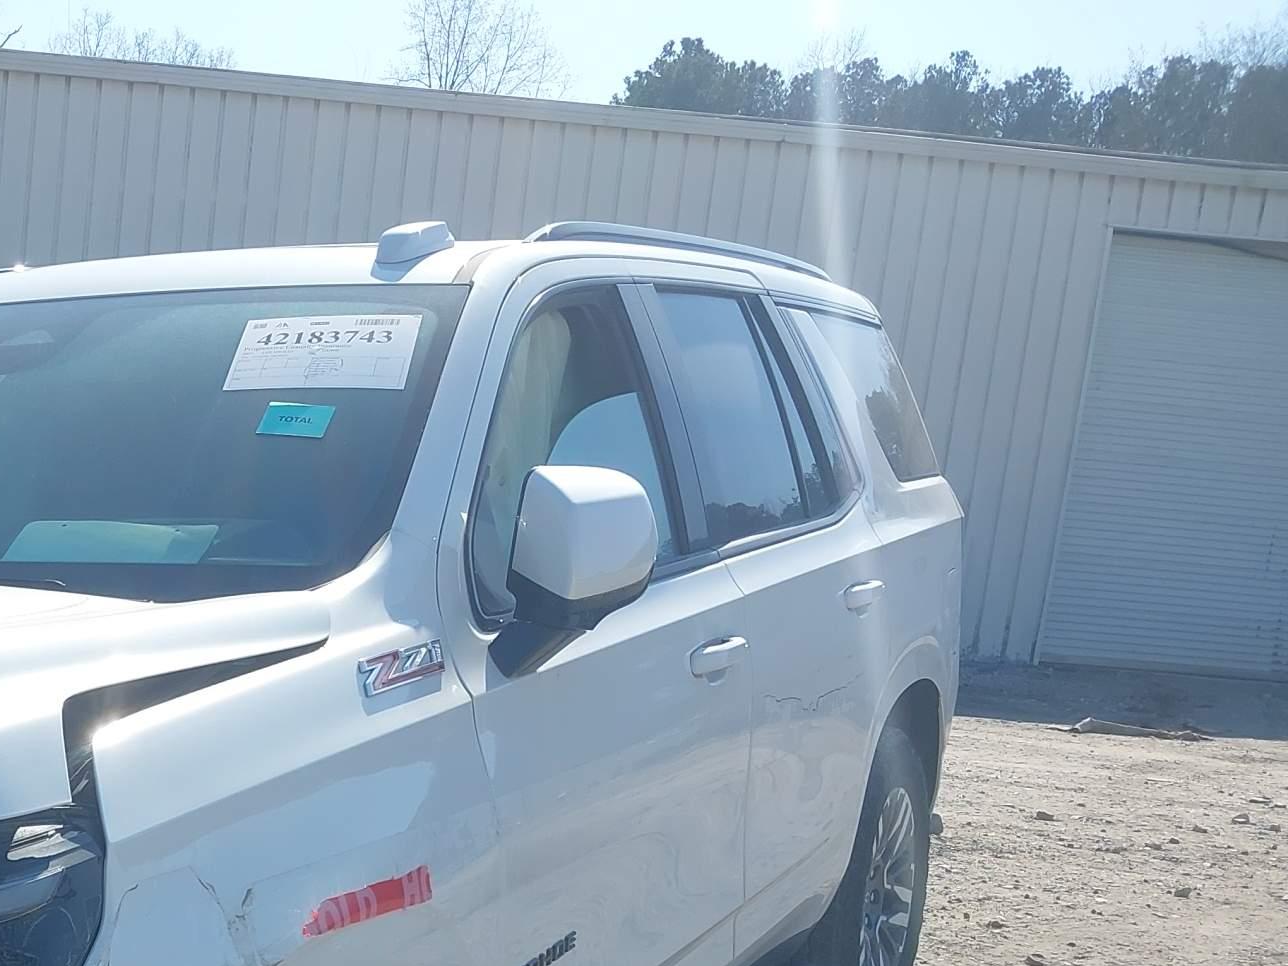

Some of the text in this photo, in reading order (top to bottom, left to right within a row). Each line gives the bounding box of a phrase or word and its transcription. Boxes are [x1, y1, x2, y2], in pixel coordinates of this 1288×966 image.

[257, 330, 393, 345] 42183743
[278, 415, 313, 425] TOTAL
[358, 639, 445, 698] Z71
